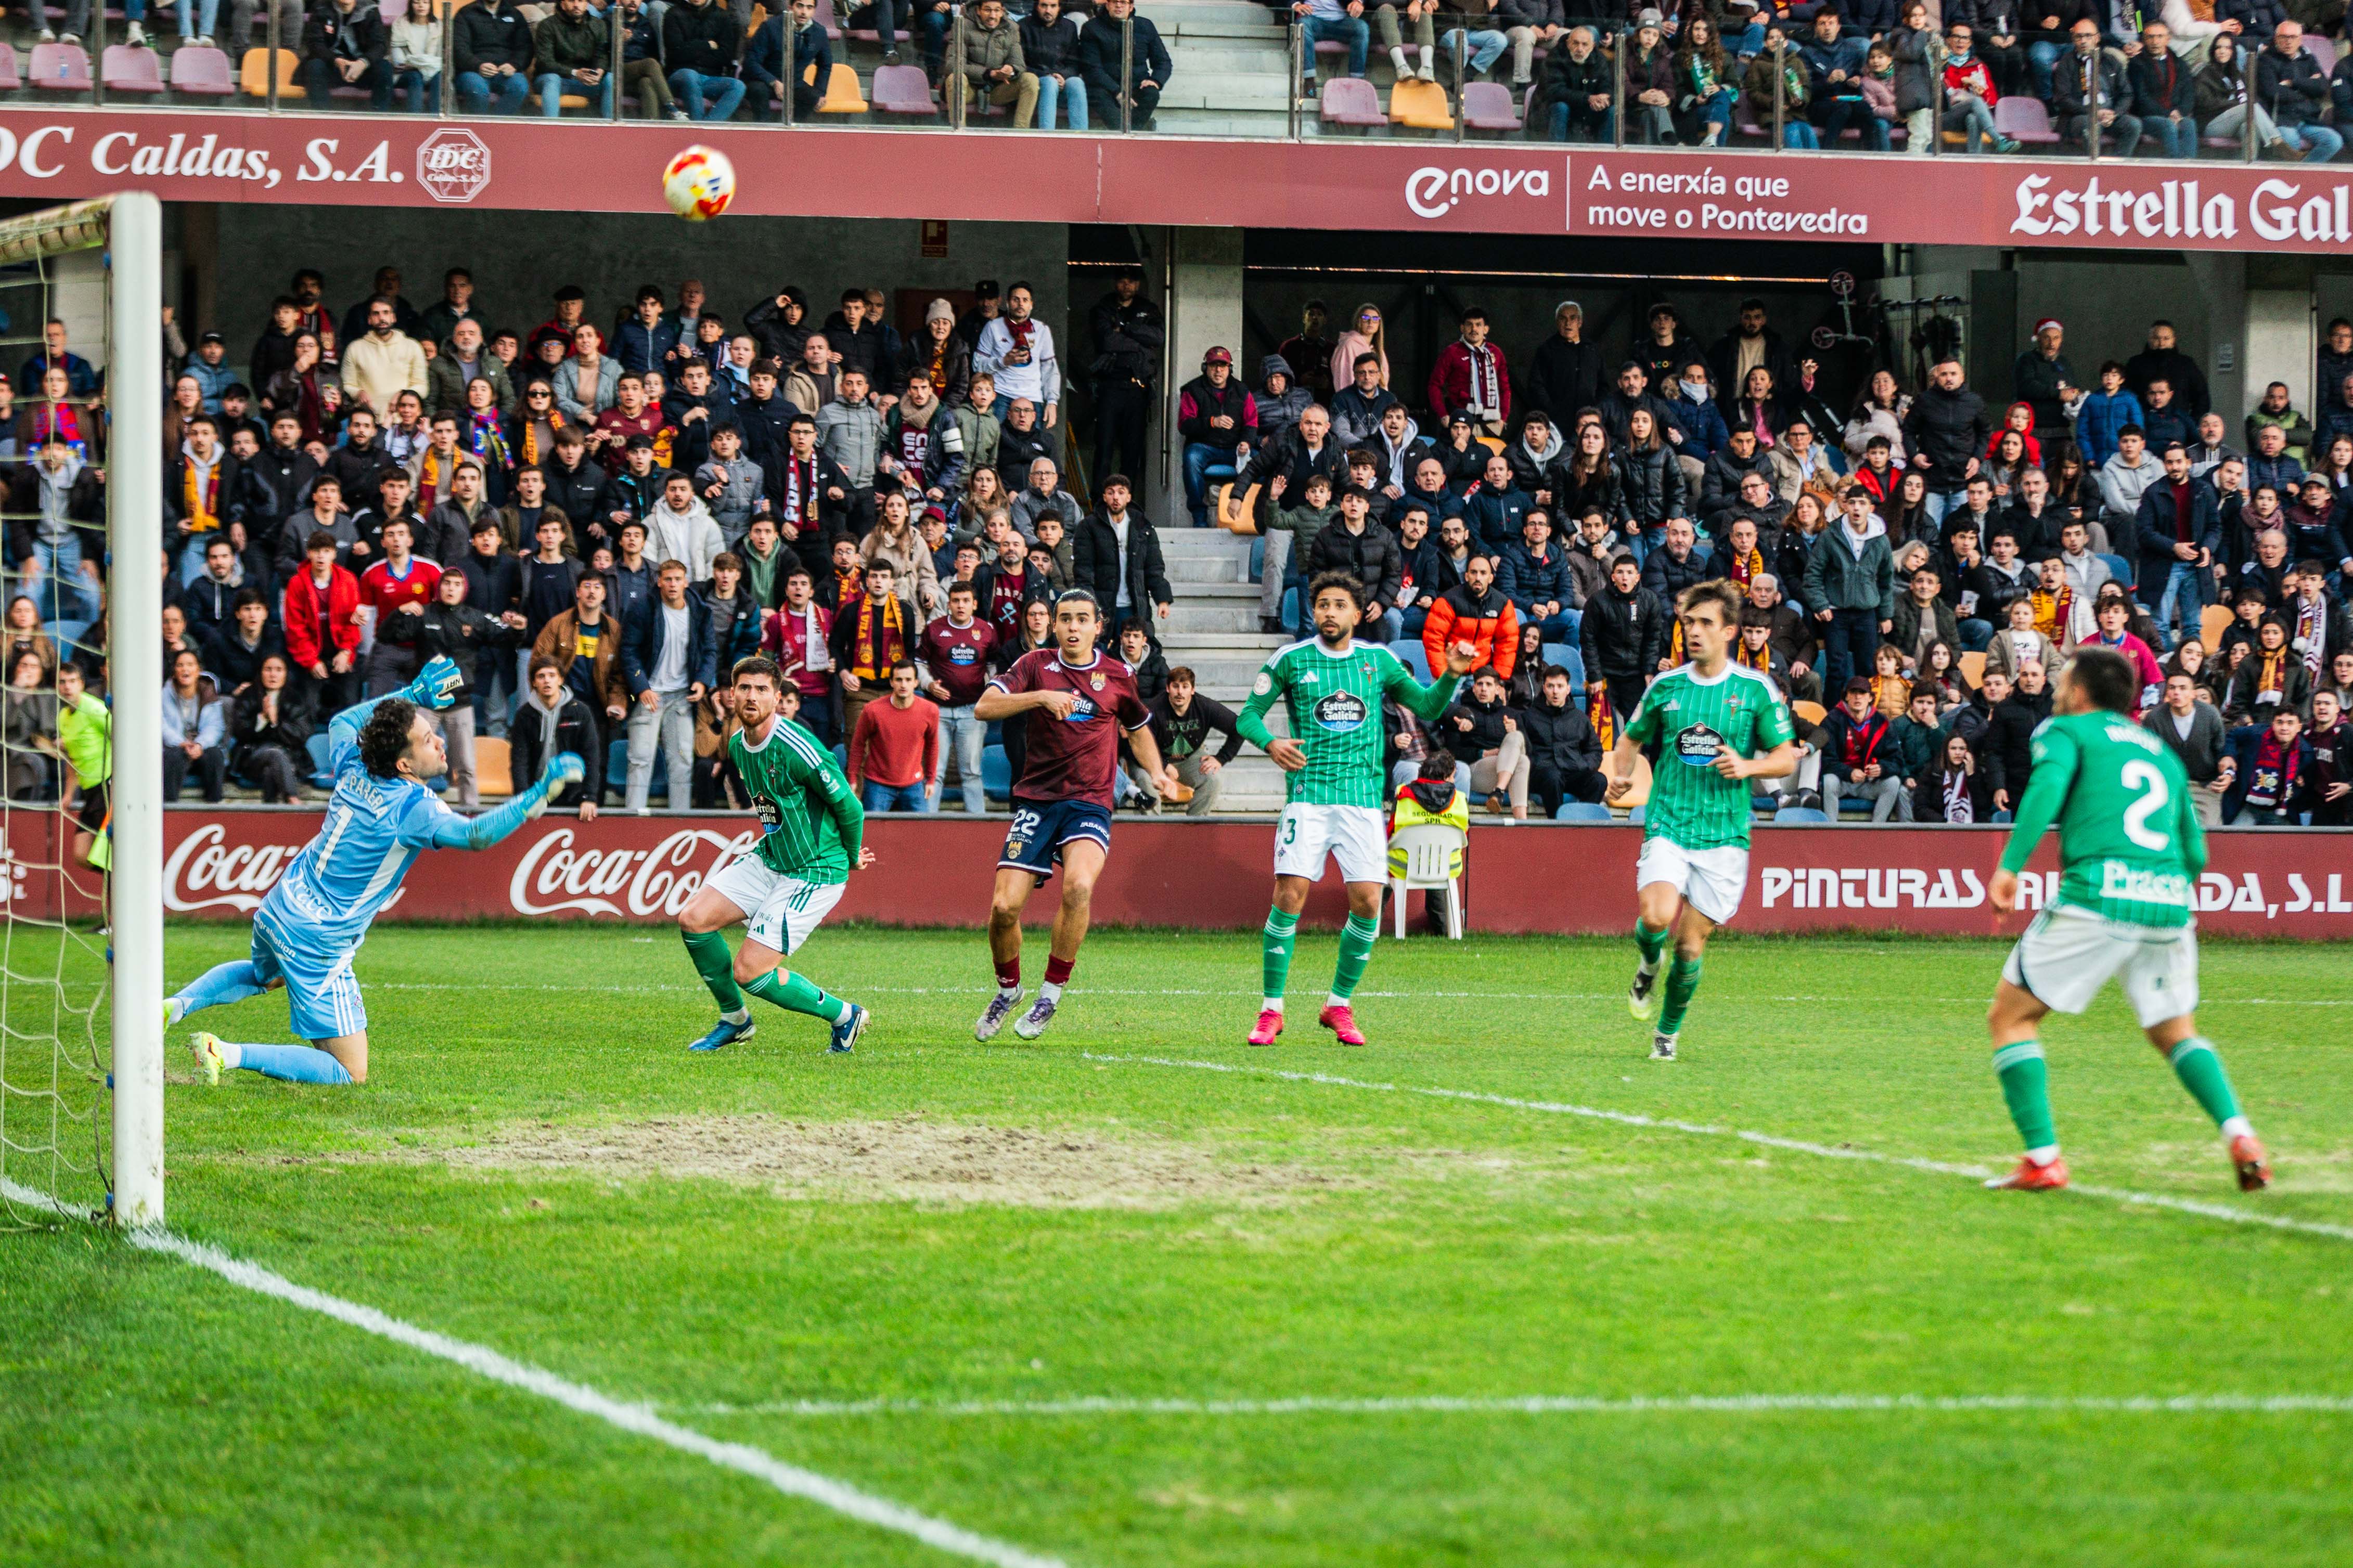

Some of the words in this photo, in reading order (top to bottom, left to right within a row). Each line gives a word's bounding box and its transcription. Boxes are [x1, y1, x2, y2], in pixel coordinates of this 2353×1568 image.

[91, 131, 281, 188] Caldas,
[297, 138, 405, 183] S.A.
[1405, 166, 1549, 218] enova
[1588, 165, 1612, 191] A
[1620, 167, 1726, 196] enerxía
[1735, 175, 1789, 205] que
[1588, 205, 1666, 228] move
[1675, 210, 1692, 229] o
[1702, 203, 1868, 235] Pontevedra
[2009, 173, 2239, 239] Estrella
[1322, 701, 1361, 711] Estrella
[1324, 710, 1359, 721] Galicia
[1680, 734, 1720, 745] Estrella
[1681, 744, 1716, 755] Galicia
[756, 804, 776, 814] strella
[2120, 758, 2169, 852] 2
[759, 815, 777, 823] alicia
[1010, 809, 1040, 836] 22
[1080, 821, 1110, 841] ABANCA
[1283, 818, 1296, 845] 3
[315, 805, 354, 880] 1
